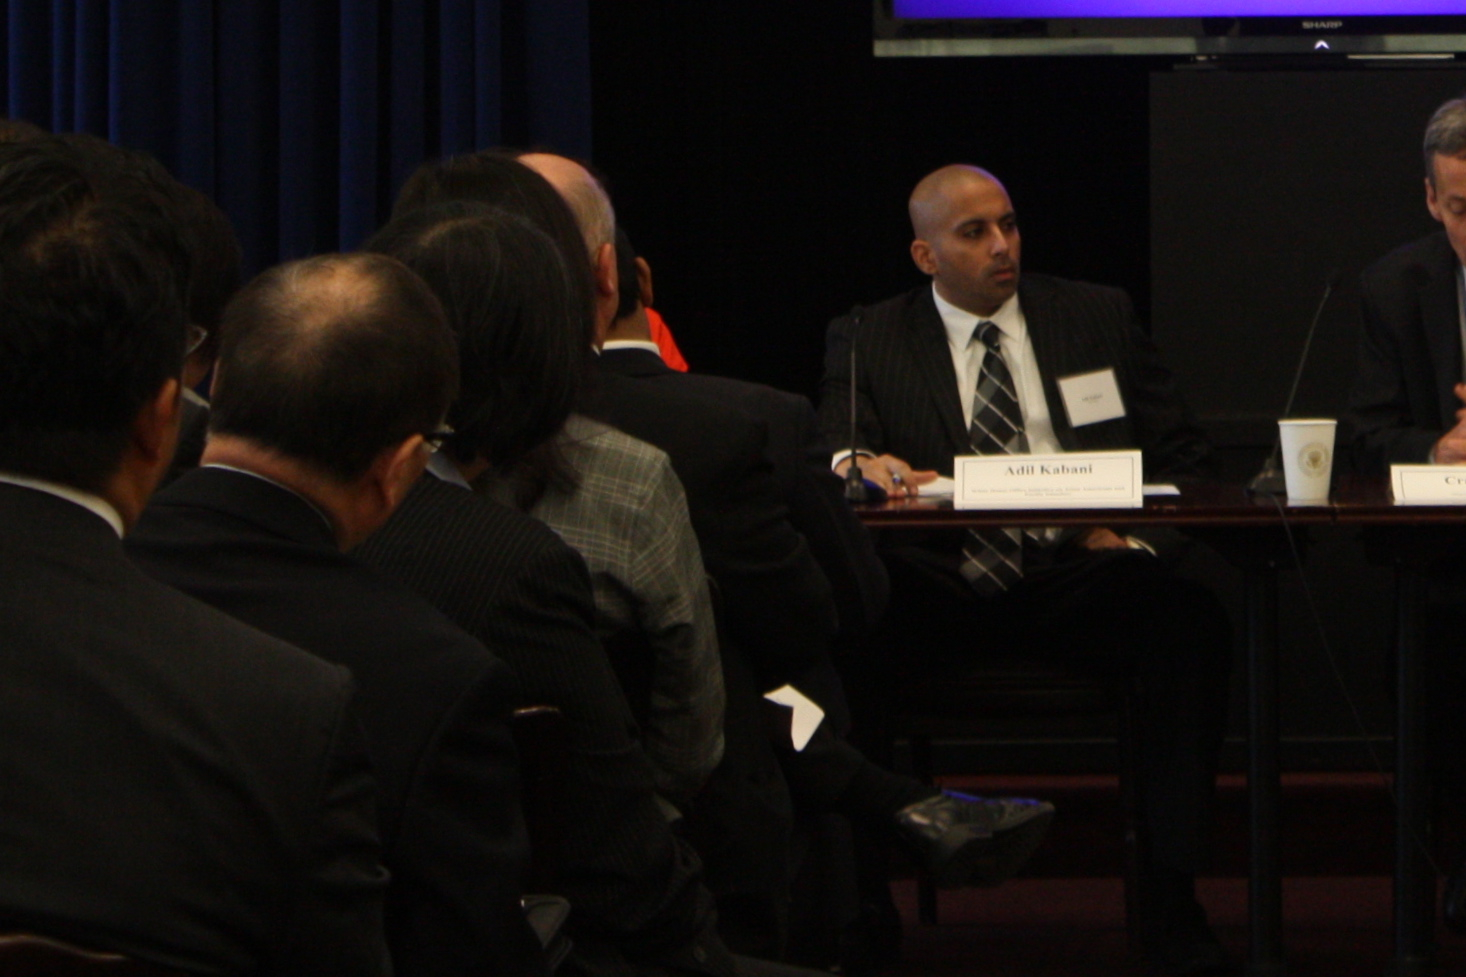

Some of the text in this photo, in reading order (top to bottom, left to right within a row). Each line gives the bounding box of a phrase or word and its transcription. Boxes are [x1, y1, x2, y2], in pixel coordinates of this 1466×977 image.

[1302, 20, 1343, 30] SHARP
[1004, 464, 1093, 477] Adil Kabani
